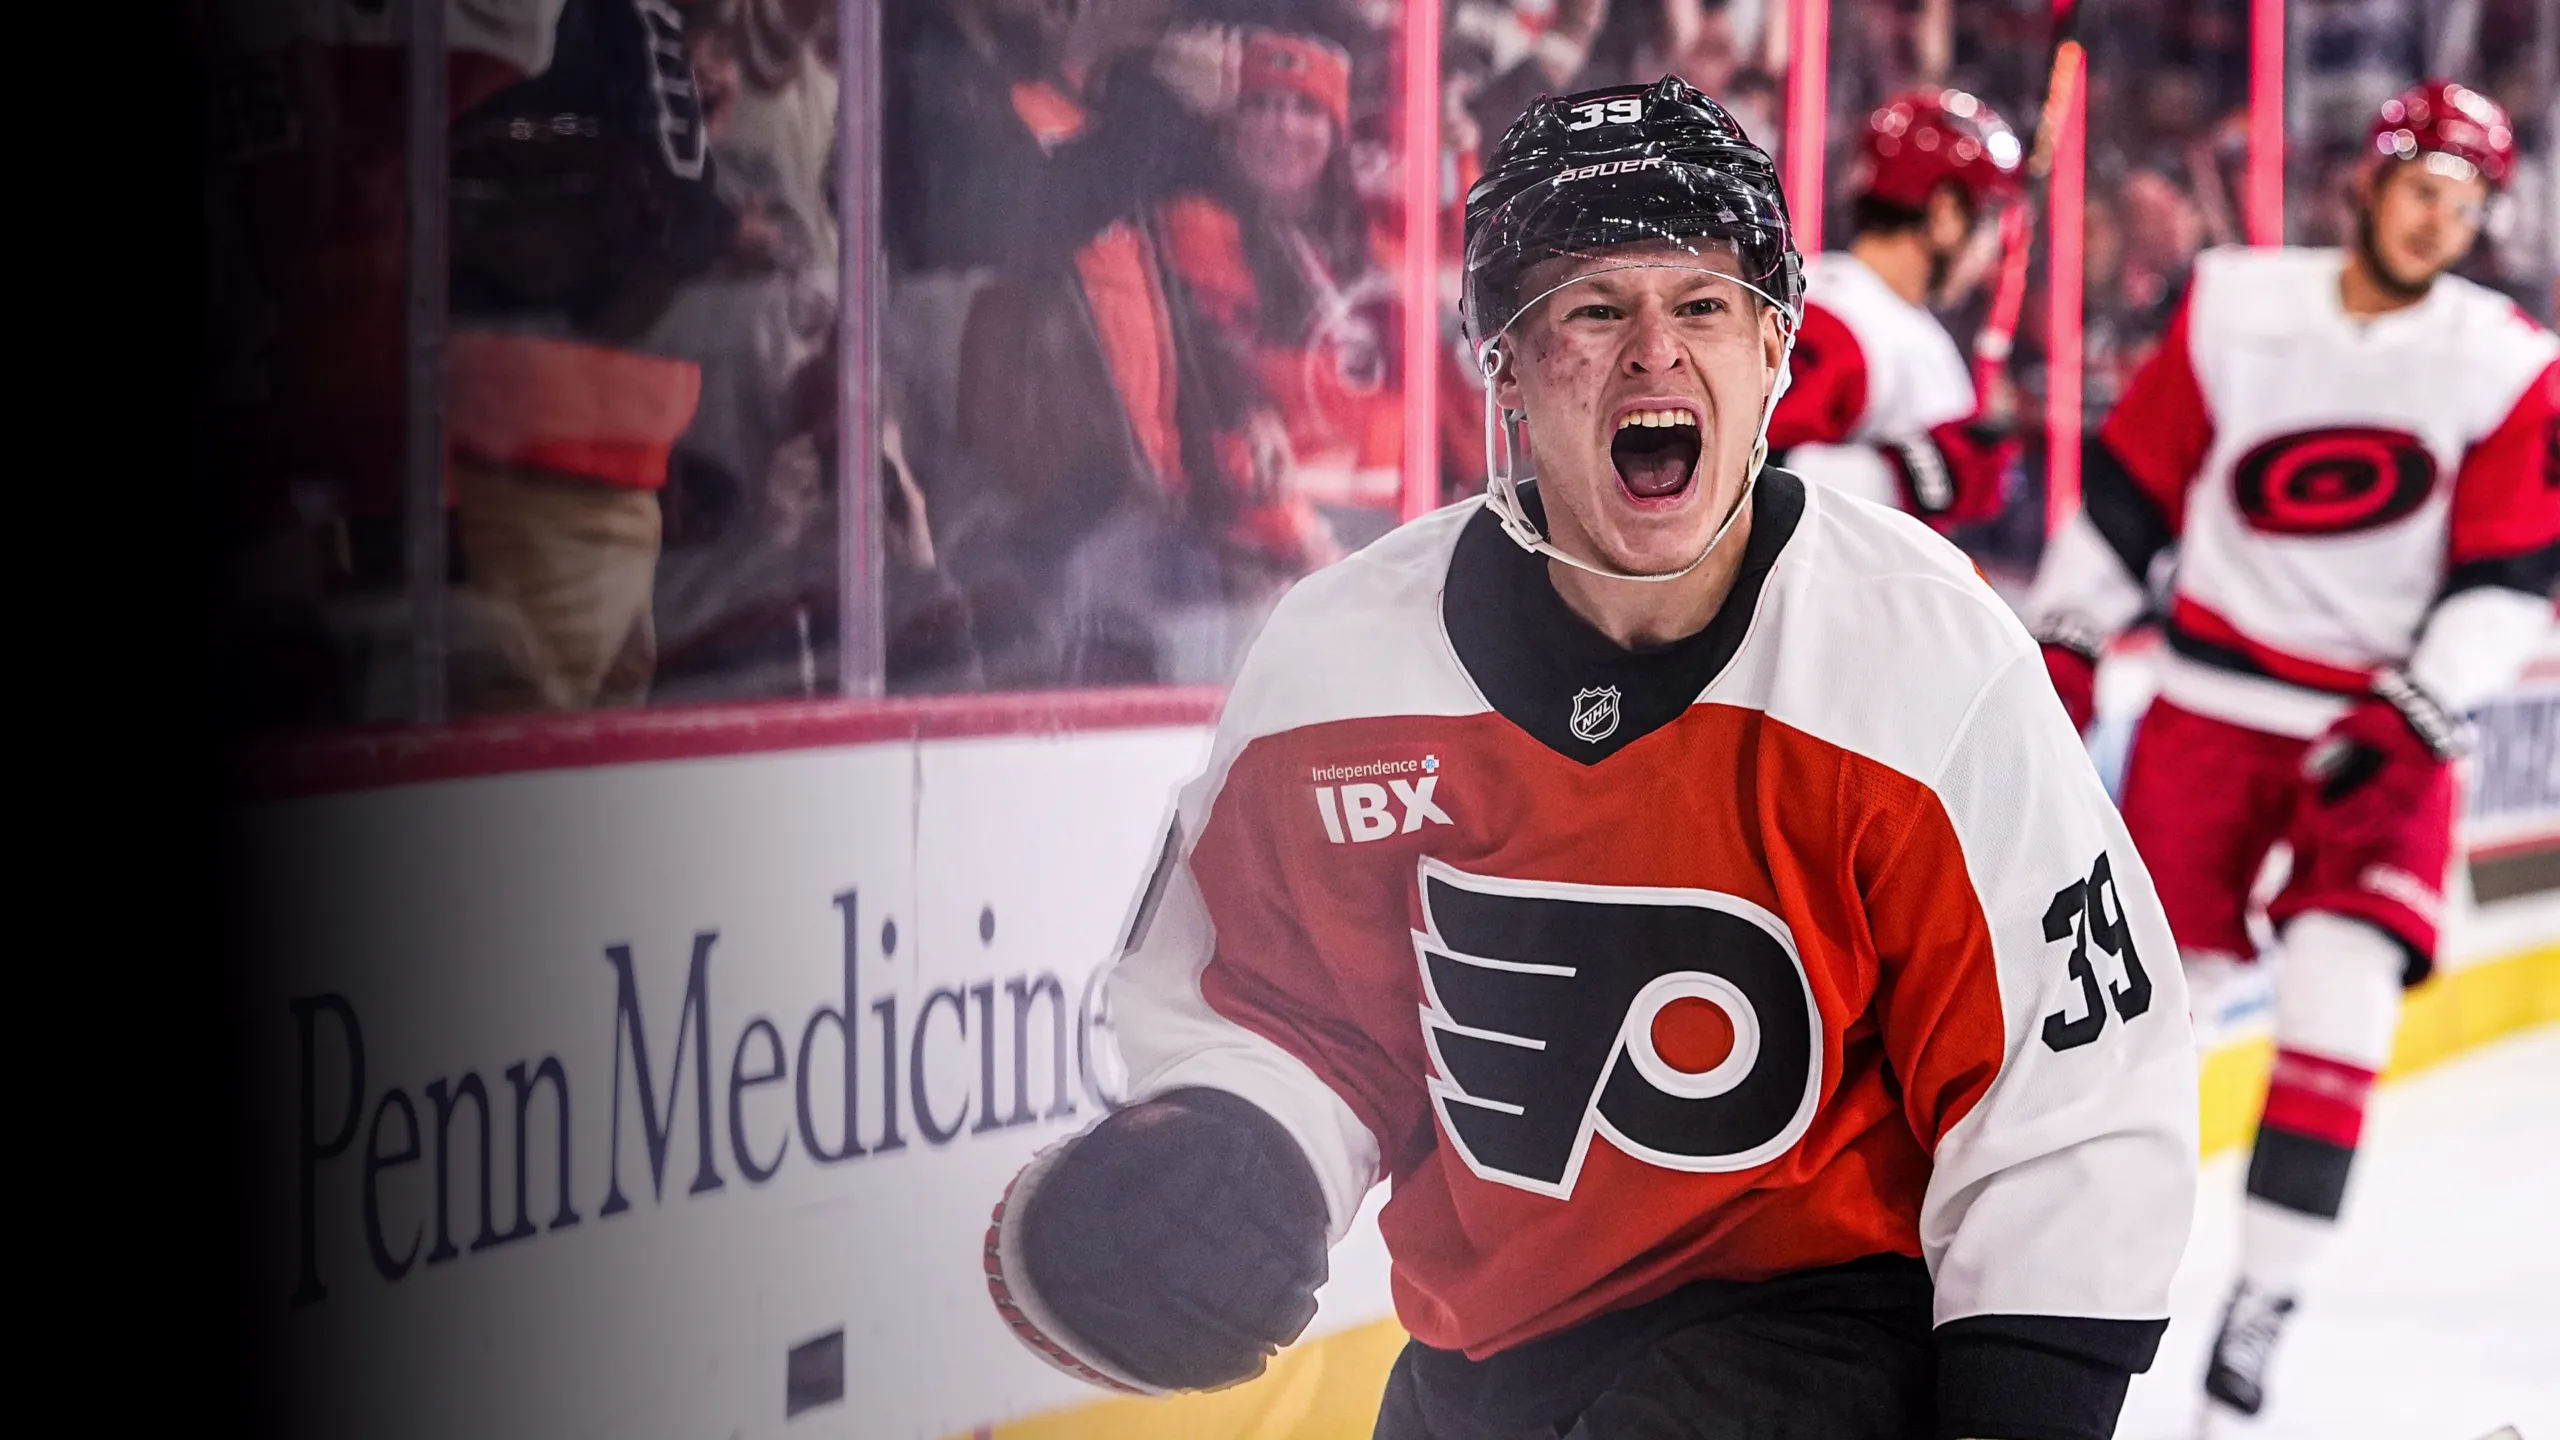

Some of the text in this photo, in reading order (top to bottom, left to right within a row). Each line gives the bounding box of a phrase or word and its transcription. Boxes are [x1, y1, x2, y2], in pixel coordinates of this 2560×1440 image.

[1570, 100, 1641, 131] 39
[1581, 700, 1612, 731] NHL
[1312, 759, 1418, 782] Independence
[1315, 775, 1455, 844] IBX
[2041, 850, 2152, 1053] 39
[290, 992, 581, 1310] Penn
